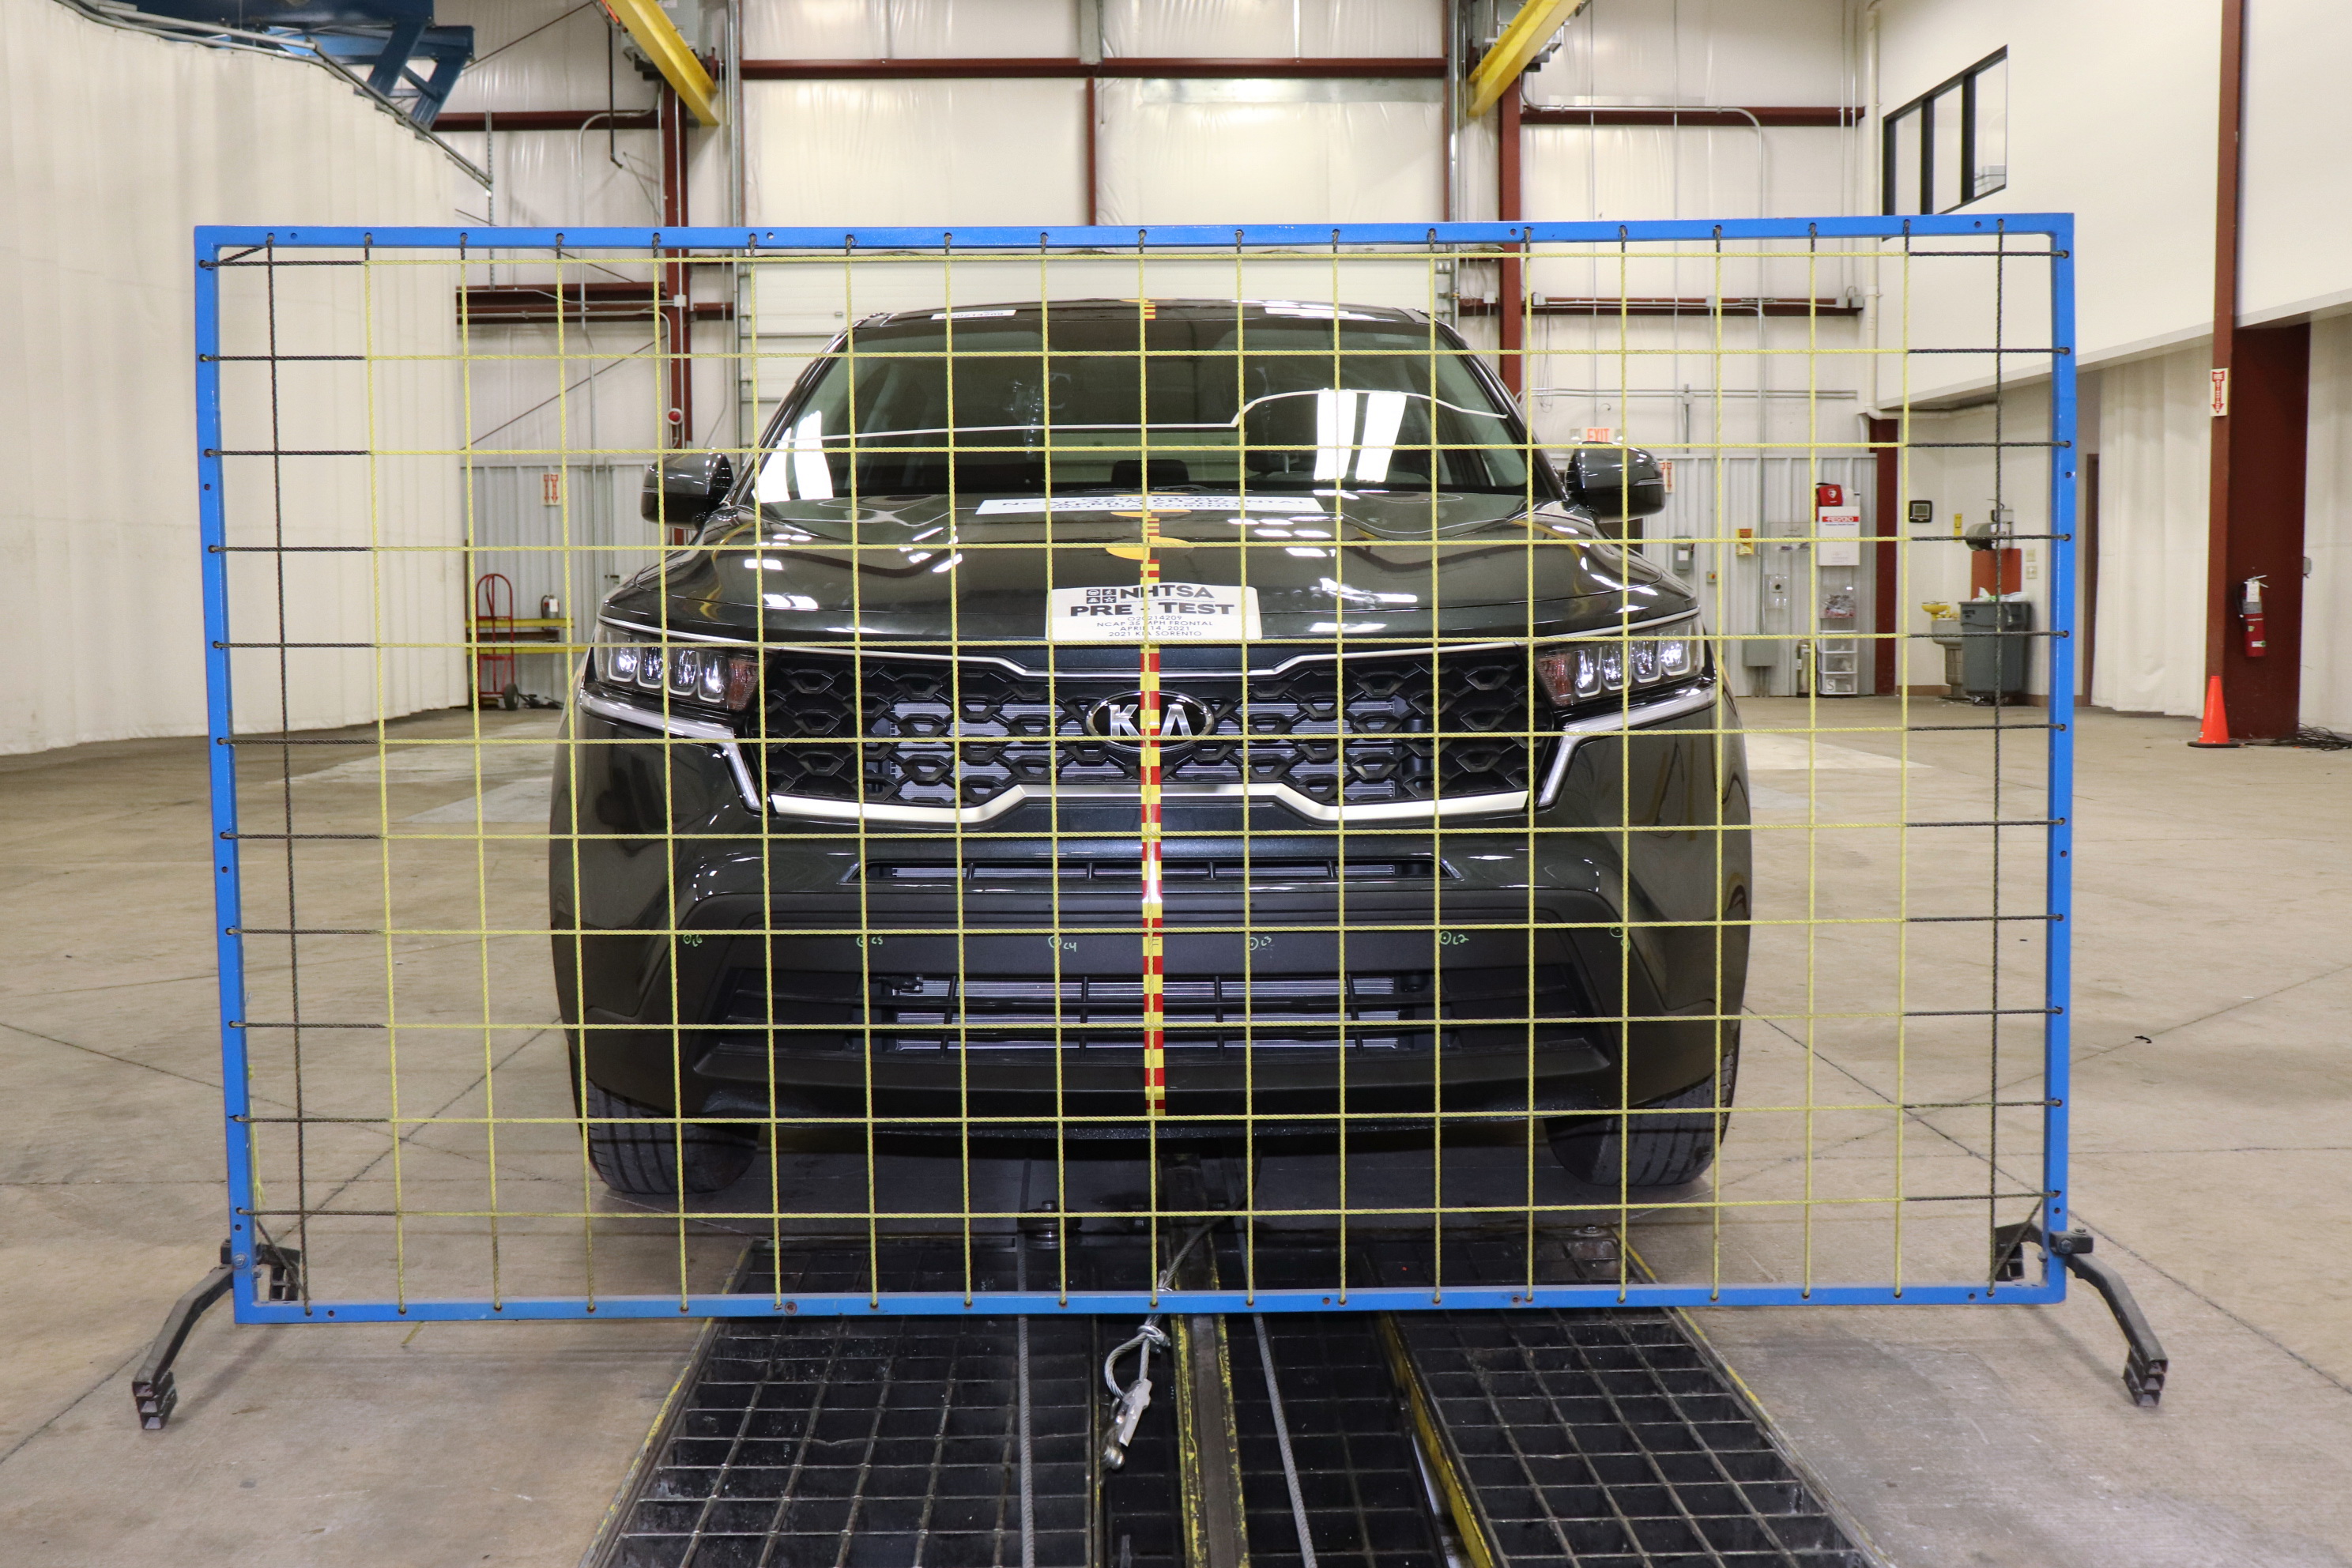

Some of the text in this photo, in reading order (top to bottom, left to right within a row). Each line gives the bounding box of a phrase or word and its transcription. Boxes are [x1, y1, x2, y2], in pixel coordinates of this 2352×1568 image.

[1587, 428, 1610, 443] EXIT
[1120, 585, 1215, 599] NHTSA
[1070, 605, 1133, 616] PRE
[1158, 601, 1234, 615] TEST
[1826, 680, 1834, 692] S
[1109, 704, 1193, 737] KA
[1063, 942, 1077, 952] C4
